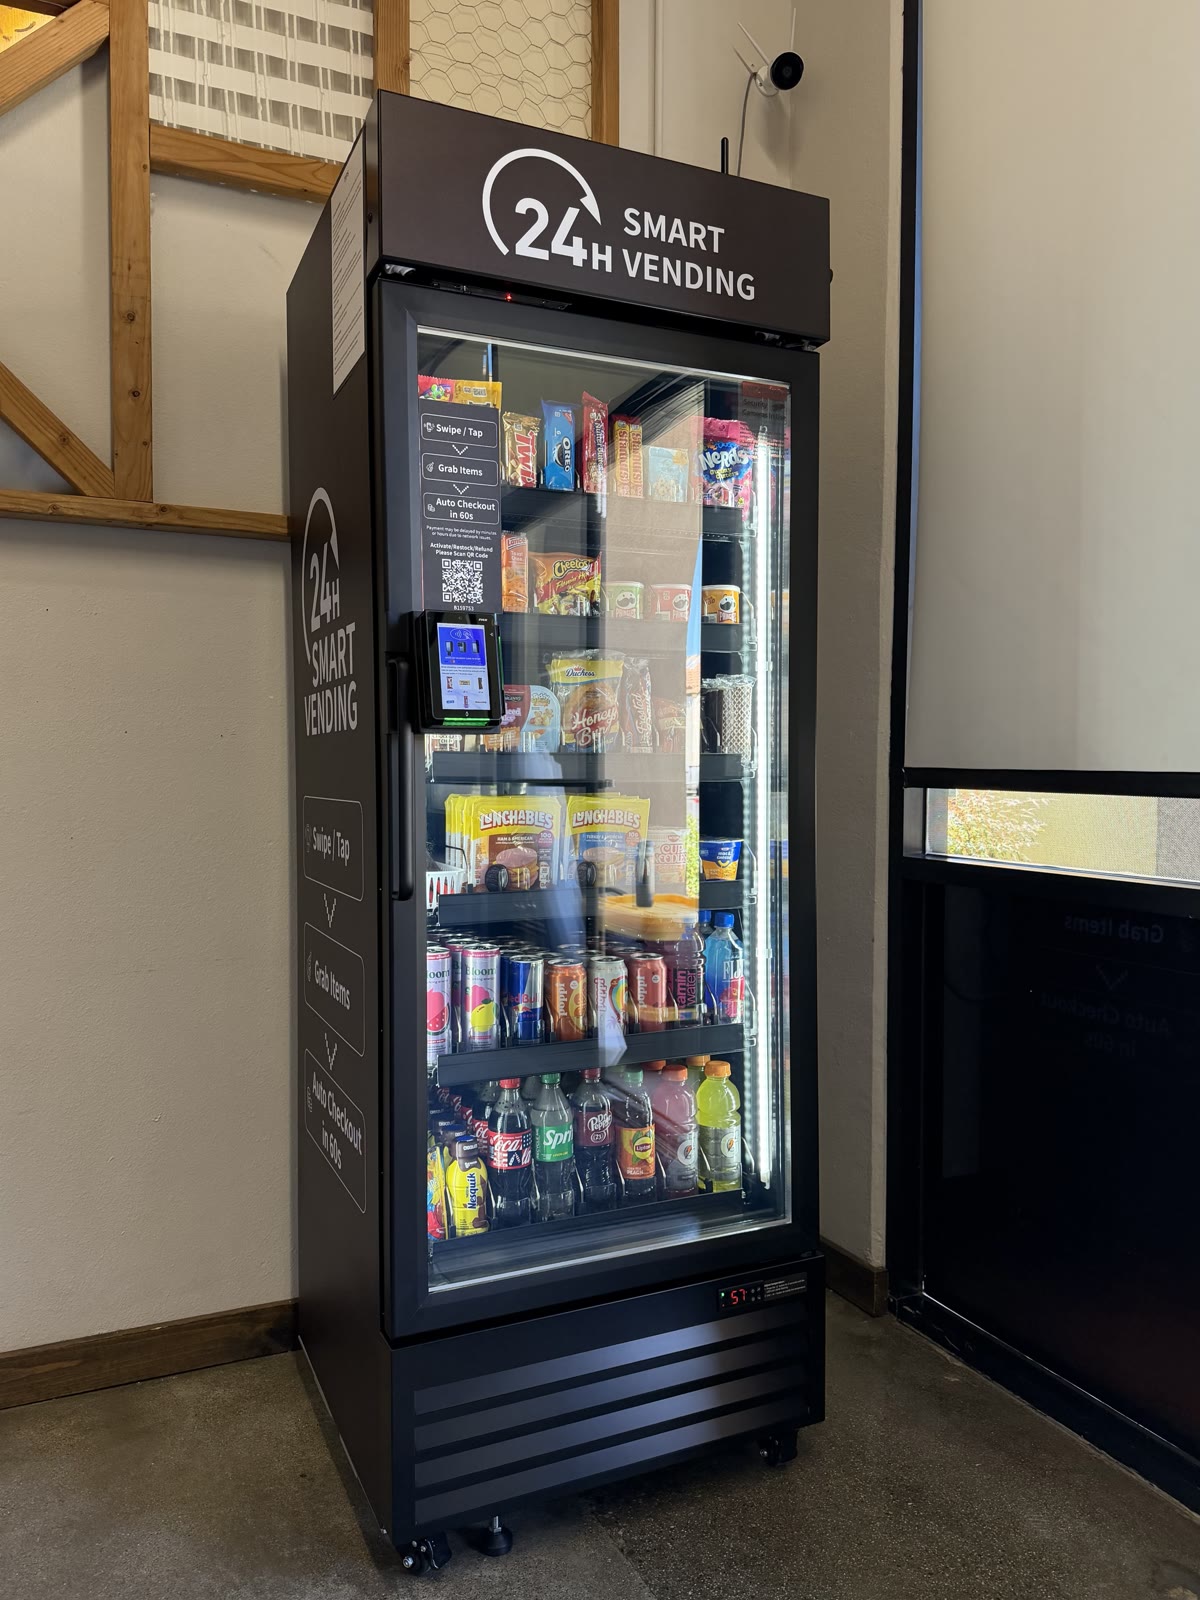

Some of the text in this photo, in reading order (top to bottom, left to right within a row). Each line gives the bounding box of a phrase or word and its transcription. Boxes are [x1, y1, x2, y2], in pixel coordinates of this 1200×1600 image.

[623, 207, 725, 253] SMART
[622, 248, 756, 301] VENDING
[436, 423, 462, 436] Swipe
[468, 427, 483, 438] Tap
[562, 437, 571, 472] OREO
[438, 464, 483, 477] Grab Items
[436, 498, 496, 511] Auto Checkout
[449, 509, 474, 520] in 60s
[554, 559, 588, 577] Cheetos
[312, 622, 356, 688] SMART
[566, 668, 595, 677] Duchess
[304, 680, 358, 737] VENDING
[571, 708, 618, 733] Honey
[480, 809, 553, 831] LUNCHABLES
[572, 809, 641, 829] LUNCHABLES
[312, 826, 331, 859] Swipe
[336, 831, 350, 866] Tap
[314, 960, 350, 1011] Grab Items
[312, 1071, 363, 1156] Auto Checkout
[321, 1120, 342, 1170] in 60s
[543, 1124, 574, 1150] Spri
[467, 1172, 477, 1210] Nesquik
[730, 1288, 747, 1305] 57
